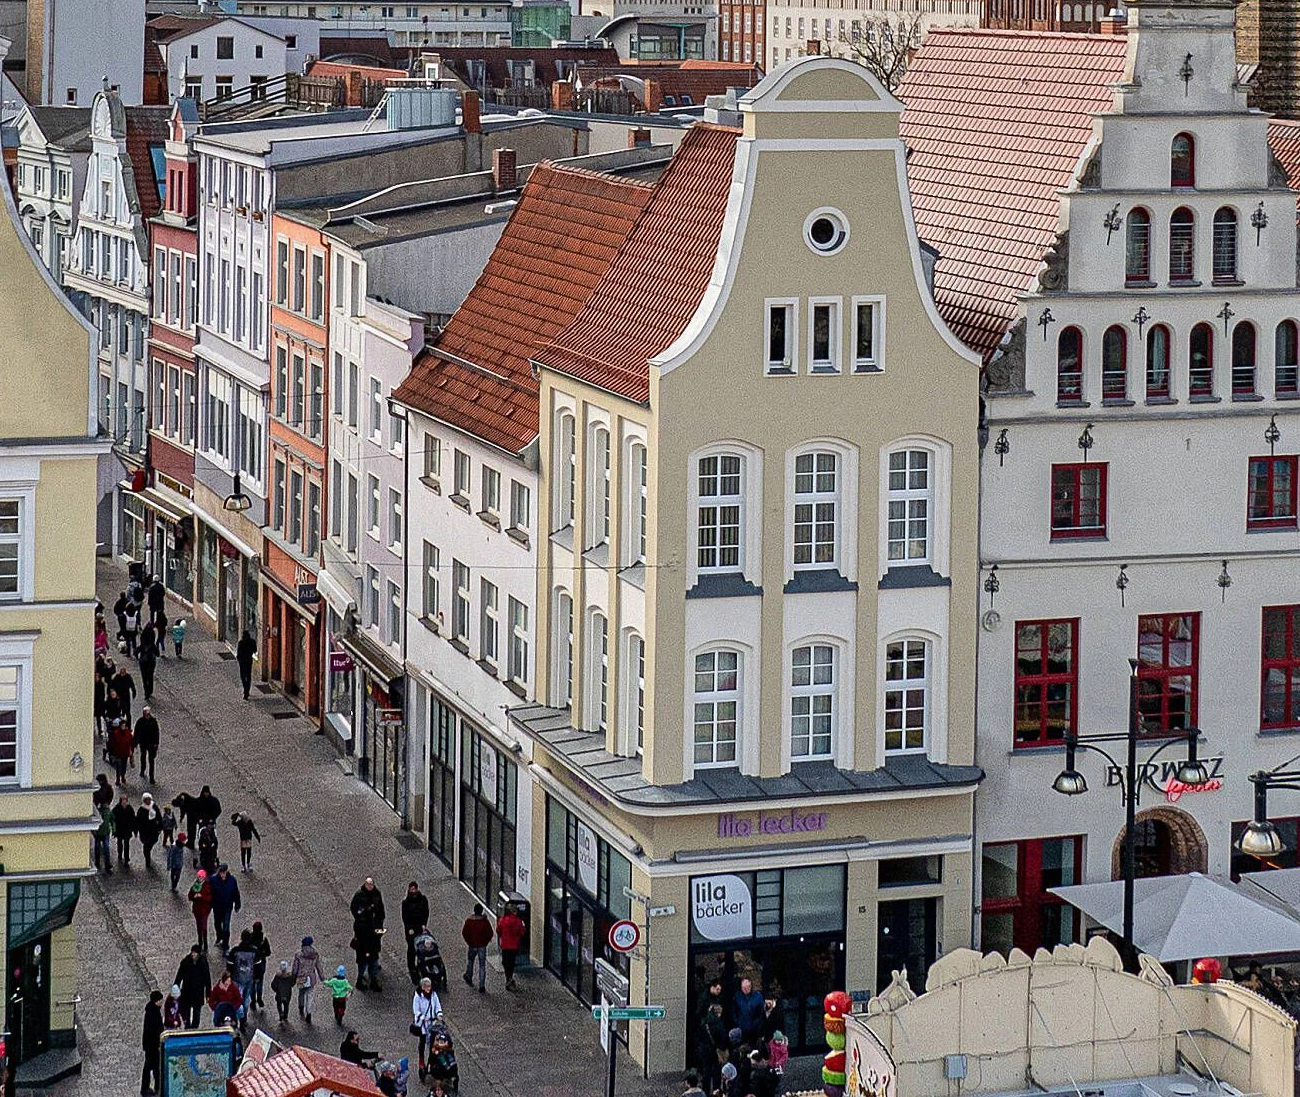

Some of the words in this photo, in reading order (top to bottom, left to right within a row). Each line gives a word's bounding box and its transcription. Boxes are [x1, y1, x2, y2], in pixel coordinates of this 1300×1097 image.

[717, 812, 752, 838] lila
[759, 808, 829, 835] lecker
[696, 881, 726, 903] lila
[696, 900, 745, 919] bäcker
